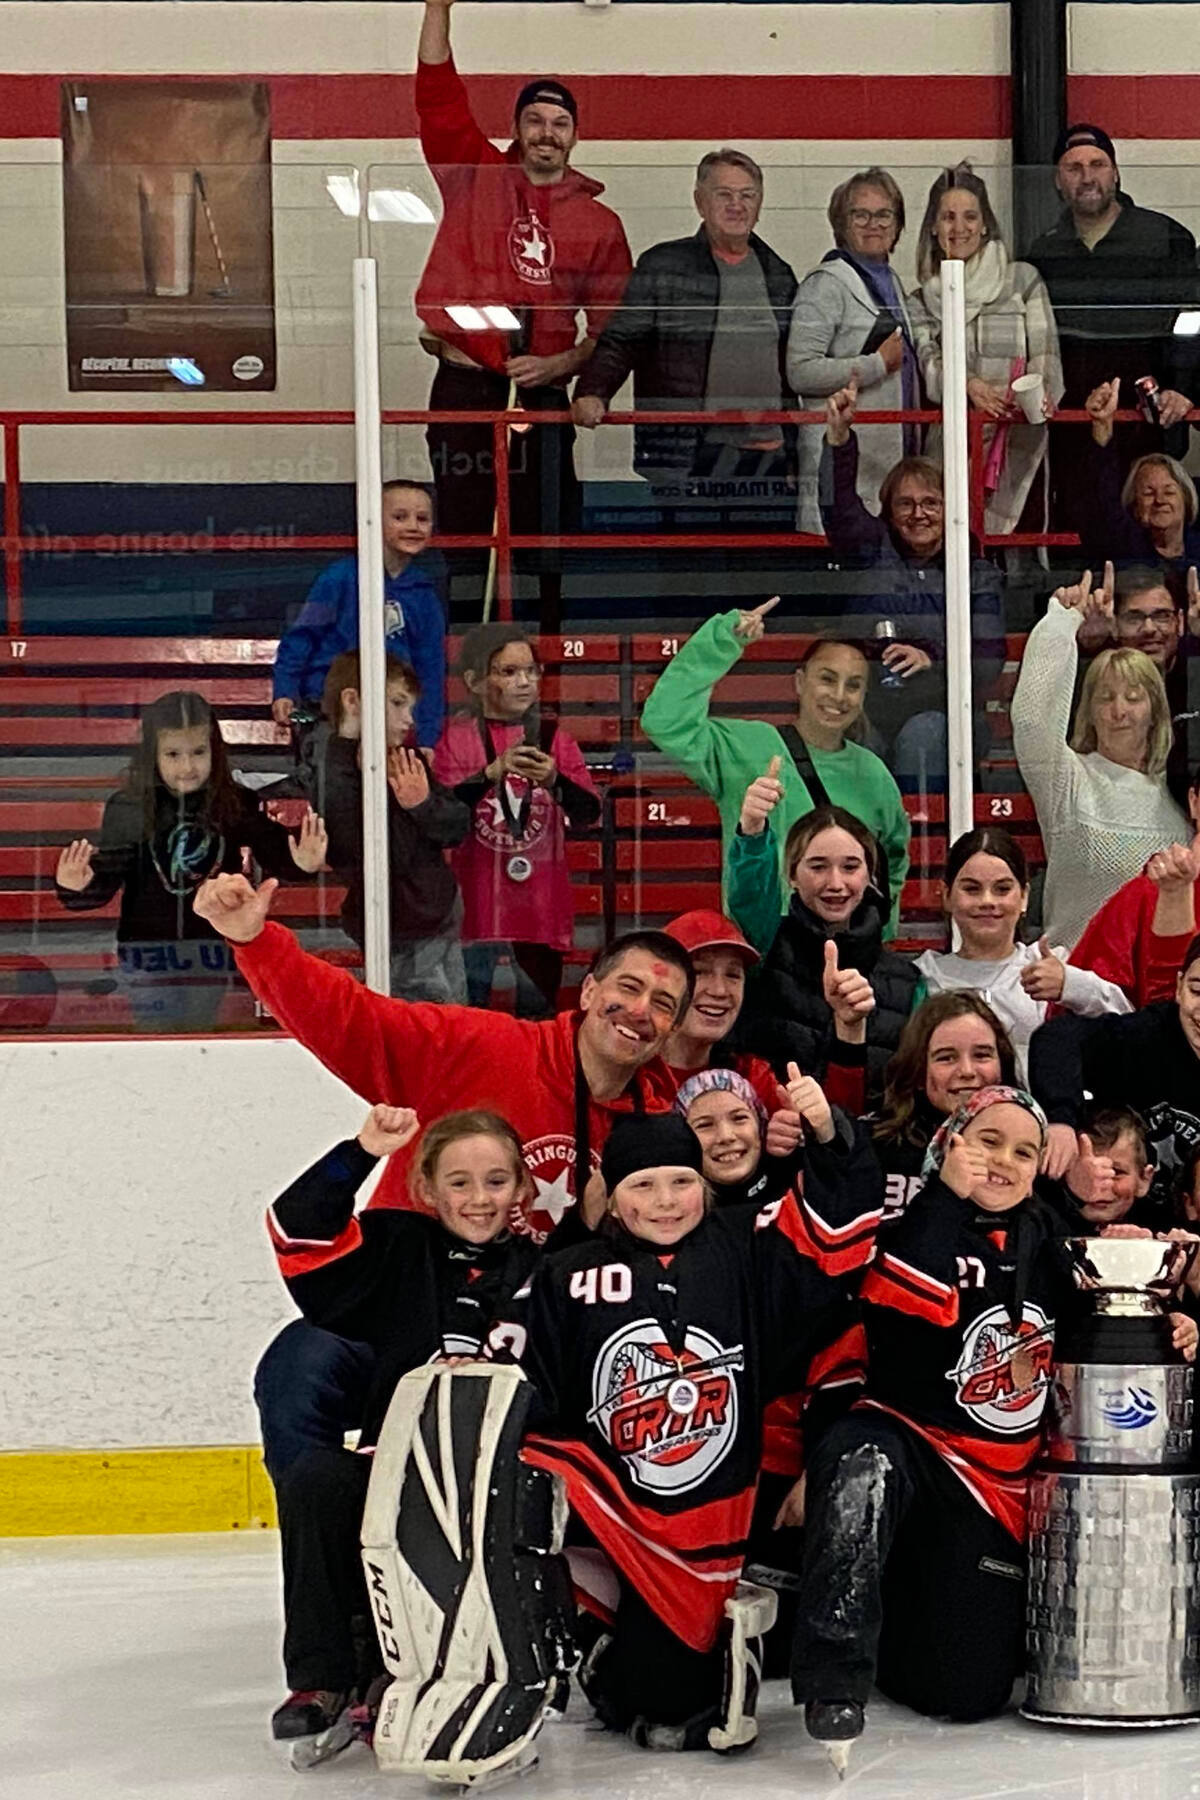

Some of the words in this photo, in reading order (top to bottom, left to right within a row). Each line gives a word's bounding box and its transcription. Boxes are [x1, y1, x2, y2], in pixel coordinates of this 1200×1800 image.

[11, 641, 27, 657] 17
[563, 640, 584, 657] 20
[661, 639, 679, 655] 21
[648, 803, 667, 821] 21
[990, 798, 1013, 817] 23
[569, 1262, 632, 1305] 40
[367, 1561, 402, 1663] CCM
